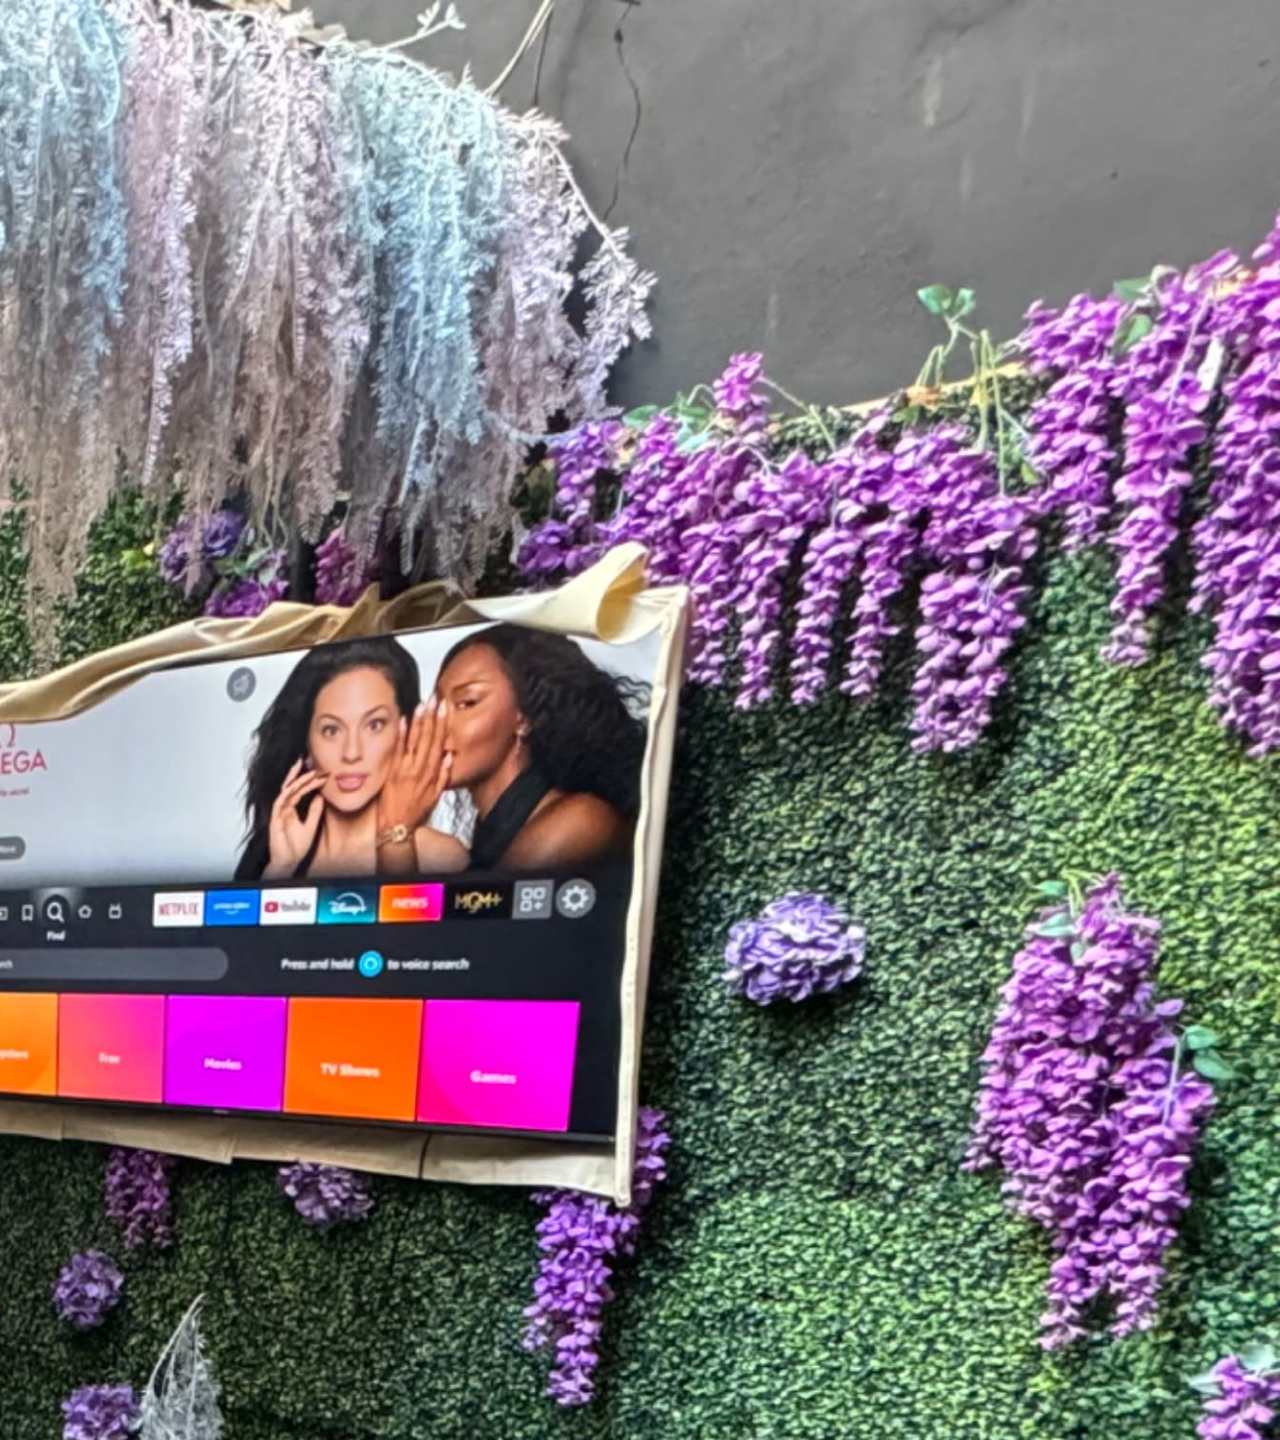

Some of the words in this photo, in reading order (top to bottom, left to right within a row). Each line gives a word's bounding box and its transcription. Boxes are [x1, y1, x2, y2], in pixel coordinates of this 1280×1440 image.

[281, 900, 311, 911] YouTube
[392, 897, 428, 908] news
[158, 902, 199, 916] NETFLIX
[46, 931, 65, 941] Find
[281, 958, 307, 969] Press
[309, 958, 328, 970] and
[331, 958, 354, 970] hold
[387, 959, 399, 970] to
[401, 958, 429, 970] voice
[432, 958, 470, 970] search
[99, 1053, 120, 1063] Free
[204, 1057, 242, 1070] Movies
[320, 1063, 338, 1075] TV
[339, 1064, 380, 1077] Shows
[470, 1070, 516, 1084] Games
